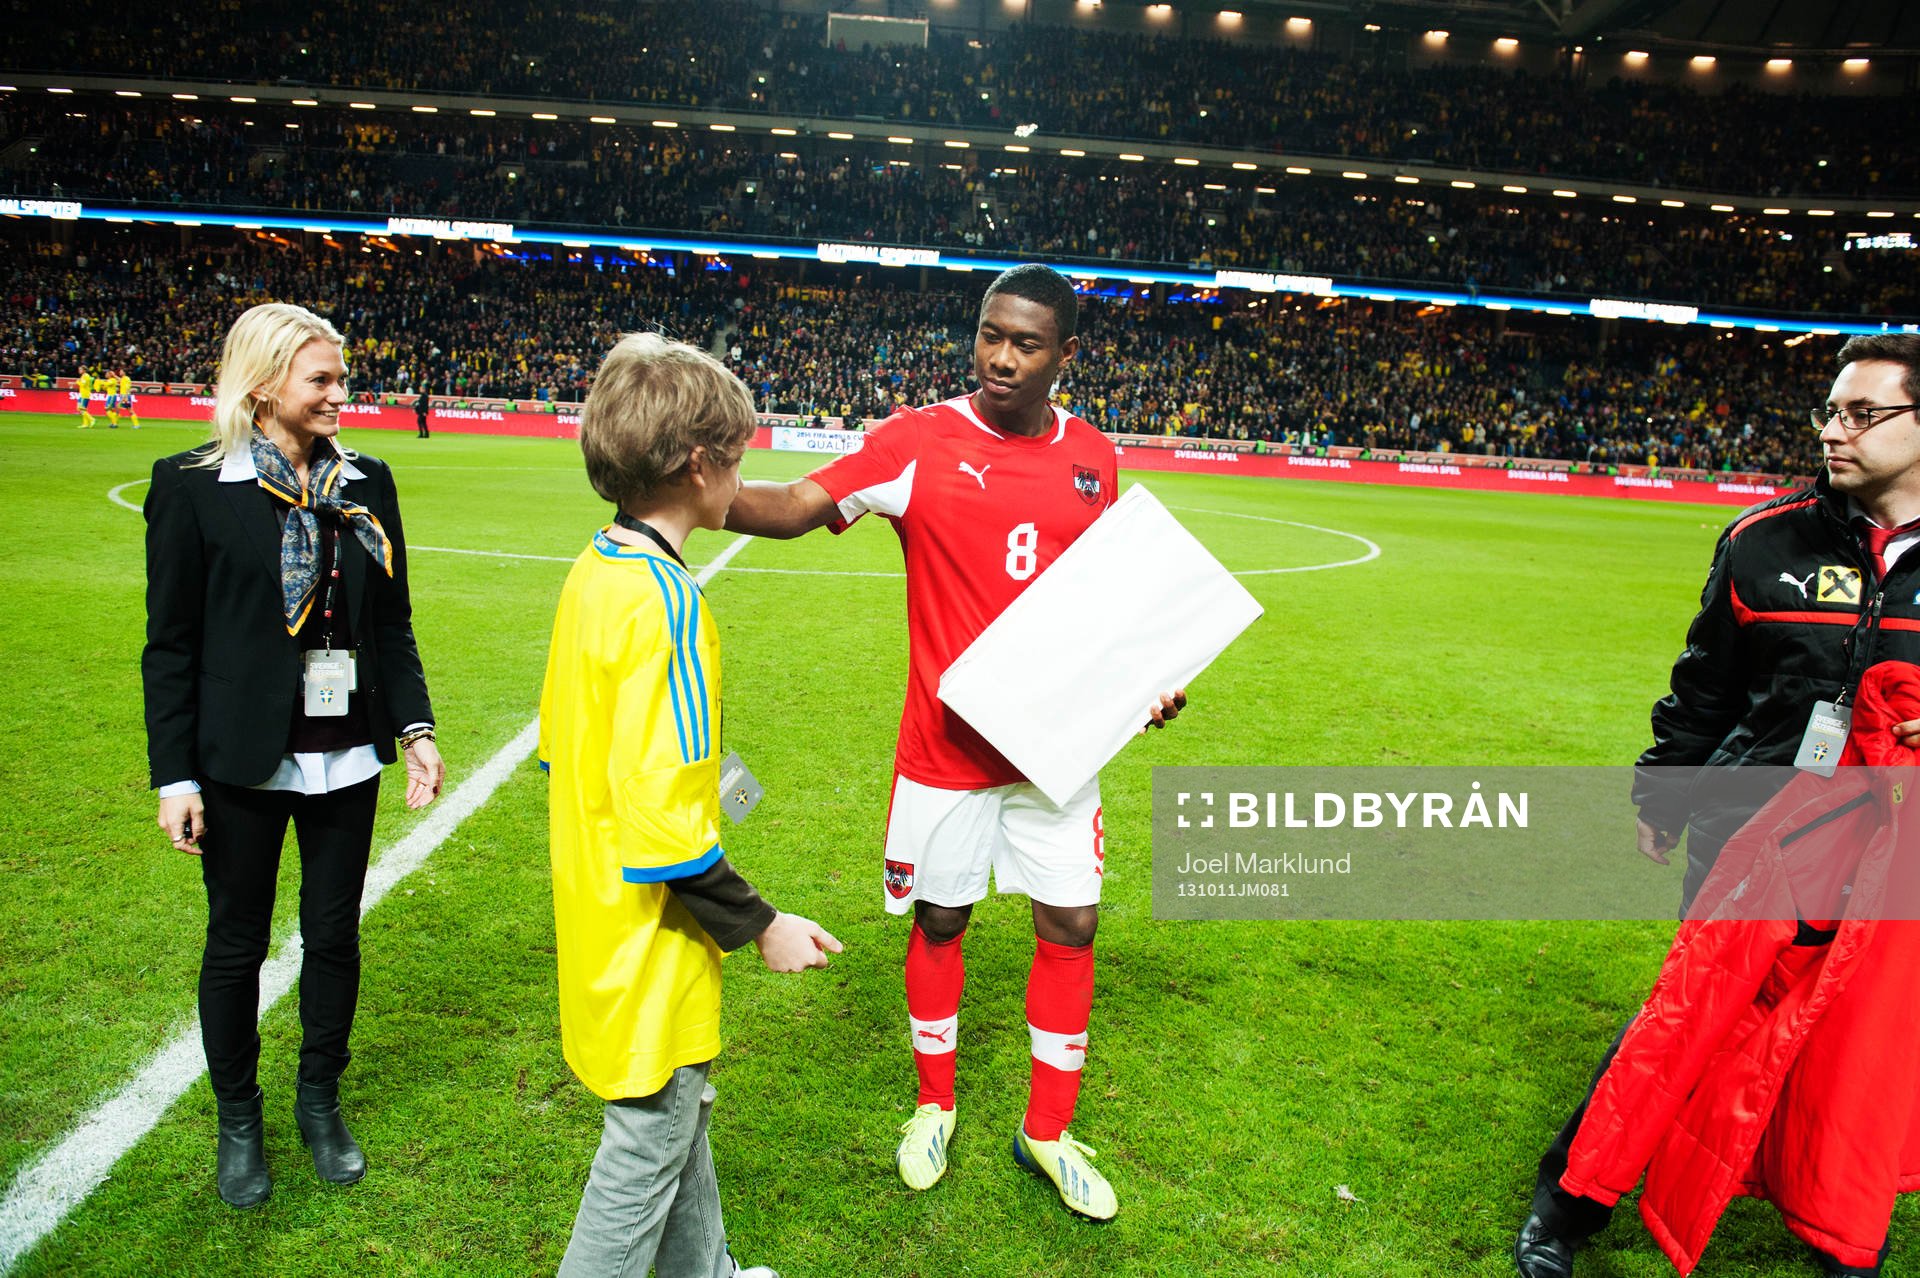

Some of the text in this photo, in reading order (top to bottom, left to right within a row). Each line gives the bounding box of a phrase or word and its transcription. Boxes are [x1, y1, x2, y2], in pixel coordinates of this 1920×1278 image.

[357, 404, 381, 415] SPEL
[434, 408, 504, 420] SVENSKA SPEL
[1174, 449, 1216, 461] SVENSKA
[1216, 452, 1240, 462] SPEL
[1287, 456, 1352, 469] SVENSKA SPEL
[1399, 463, 1461, 475] SVENSKA SPEL
[1006, 522, 1039, 581] 8
